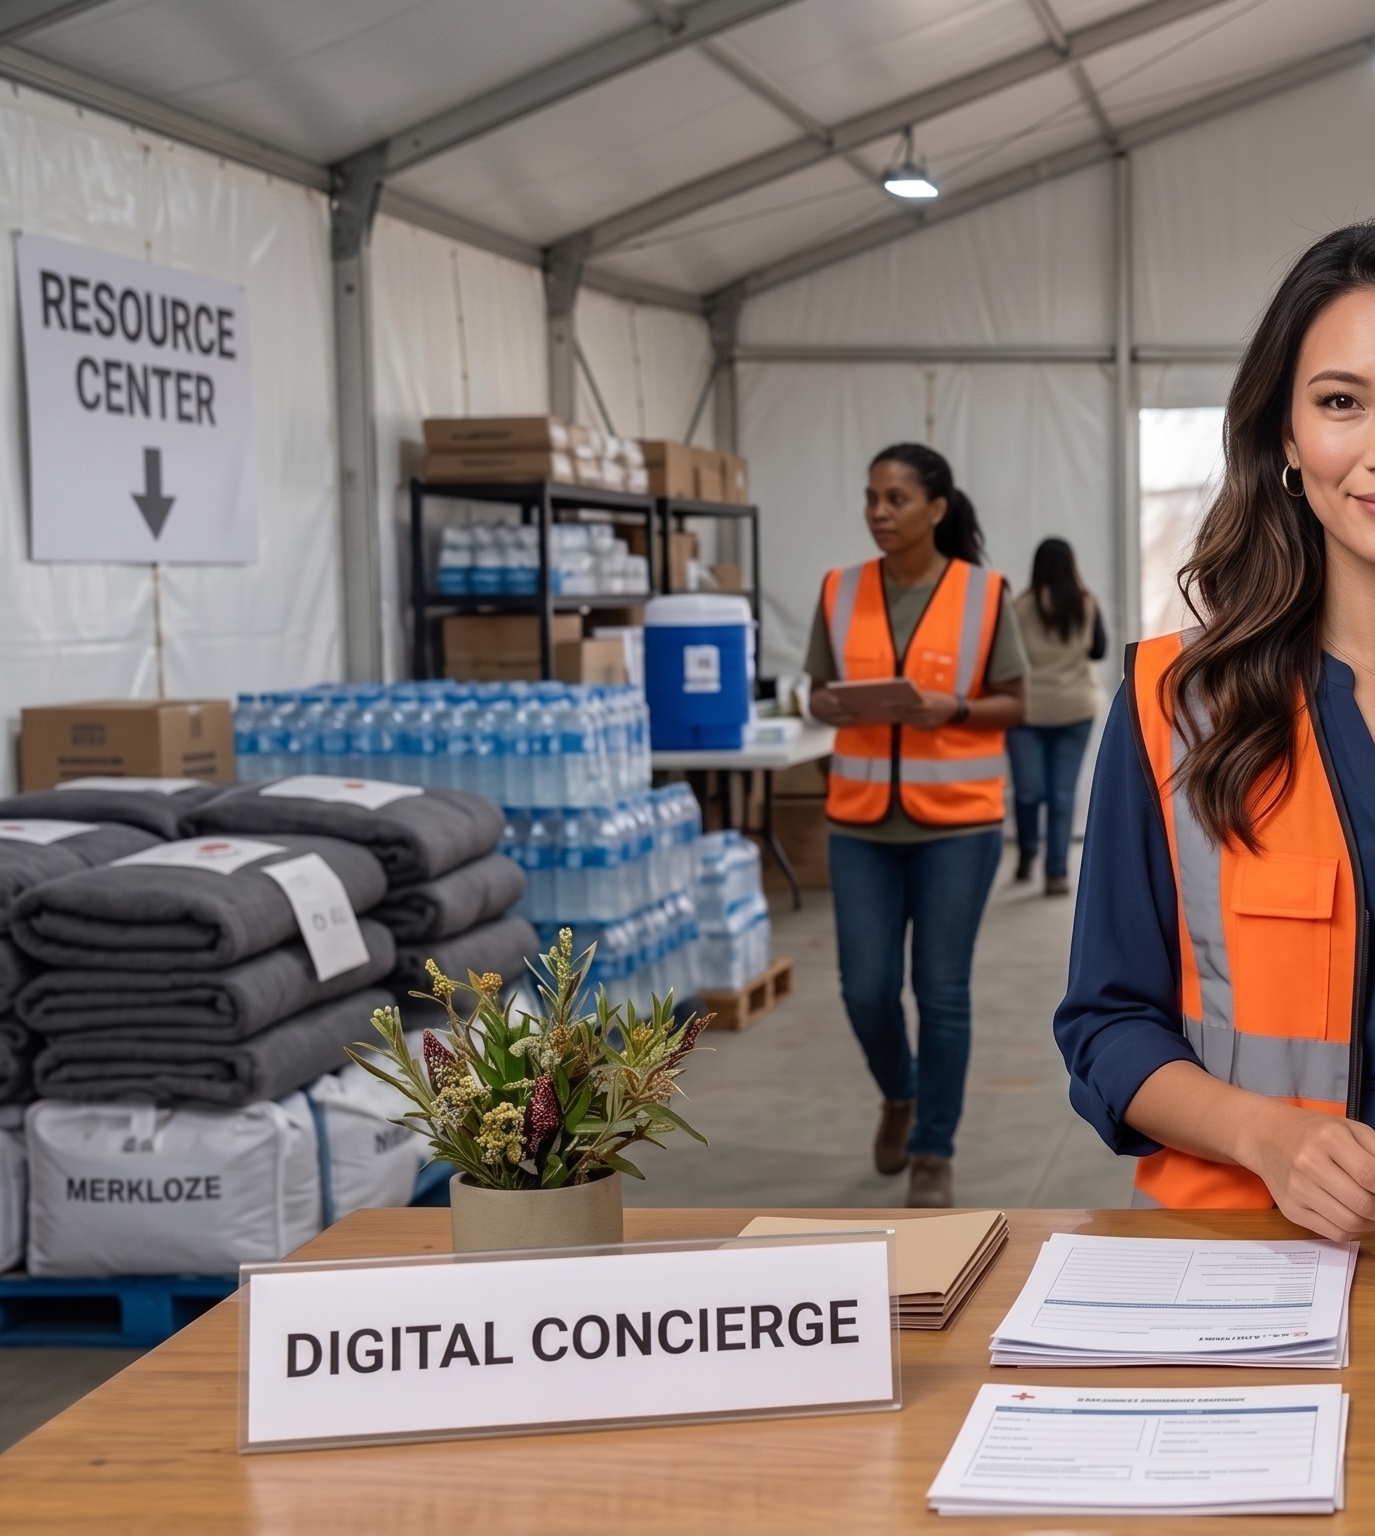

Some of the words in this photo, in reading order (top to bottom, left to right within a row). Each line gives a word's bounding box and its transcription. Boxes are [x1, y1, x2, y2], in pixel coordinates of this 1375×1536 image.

[39, 268, 237, 361] RESOURCE
[75, 355, 216, 426] CENTER
[65, 1175, 222, 1205] MERKLOZE
[287, 1321, 514, 1378] DIGITAL
[531, 1299, 860, 1362] CONCIERGE
